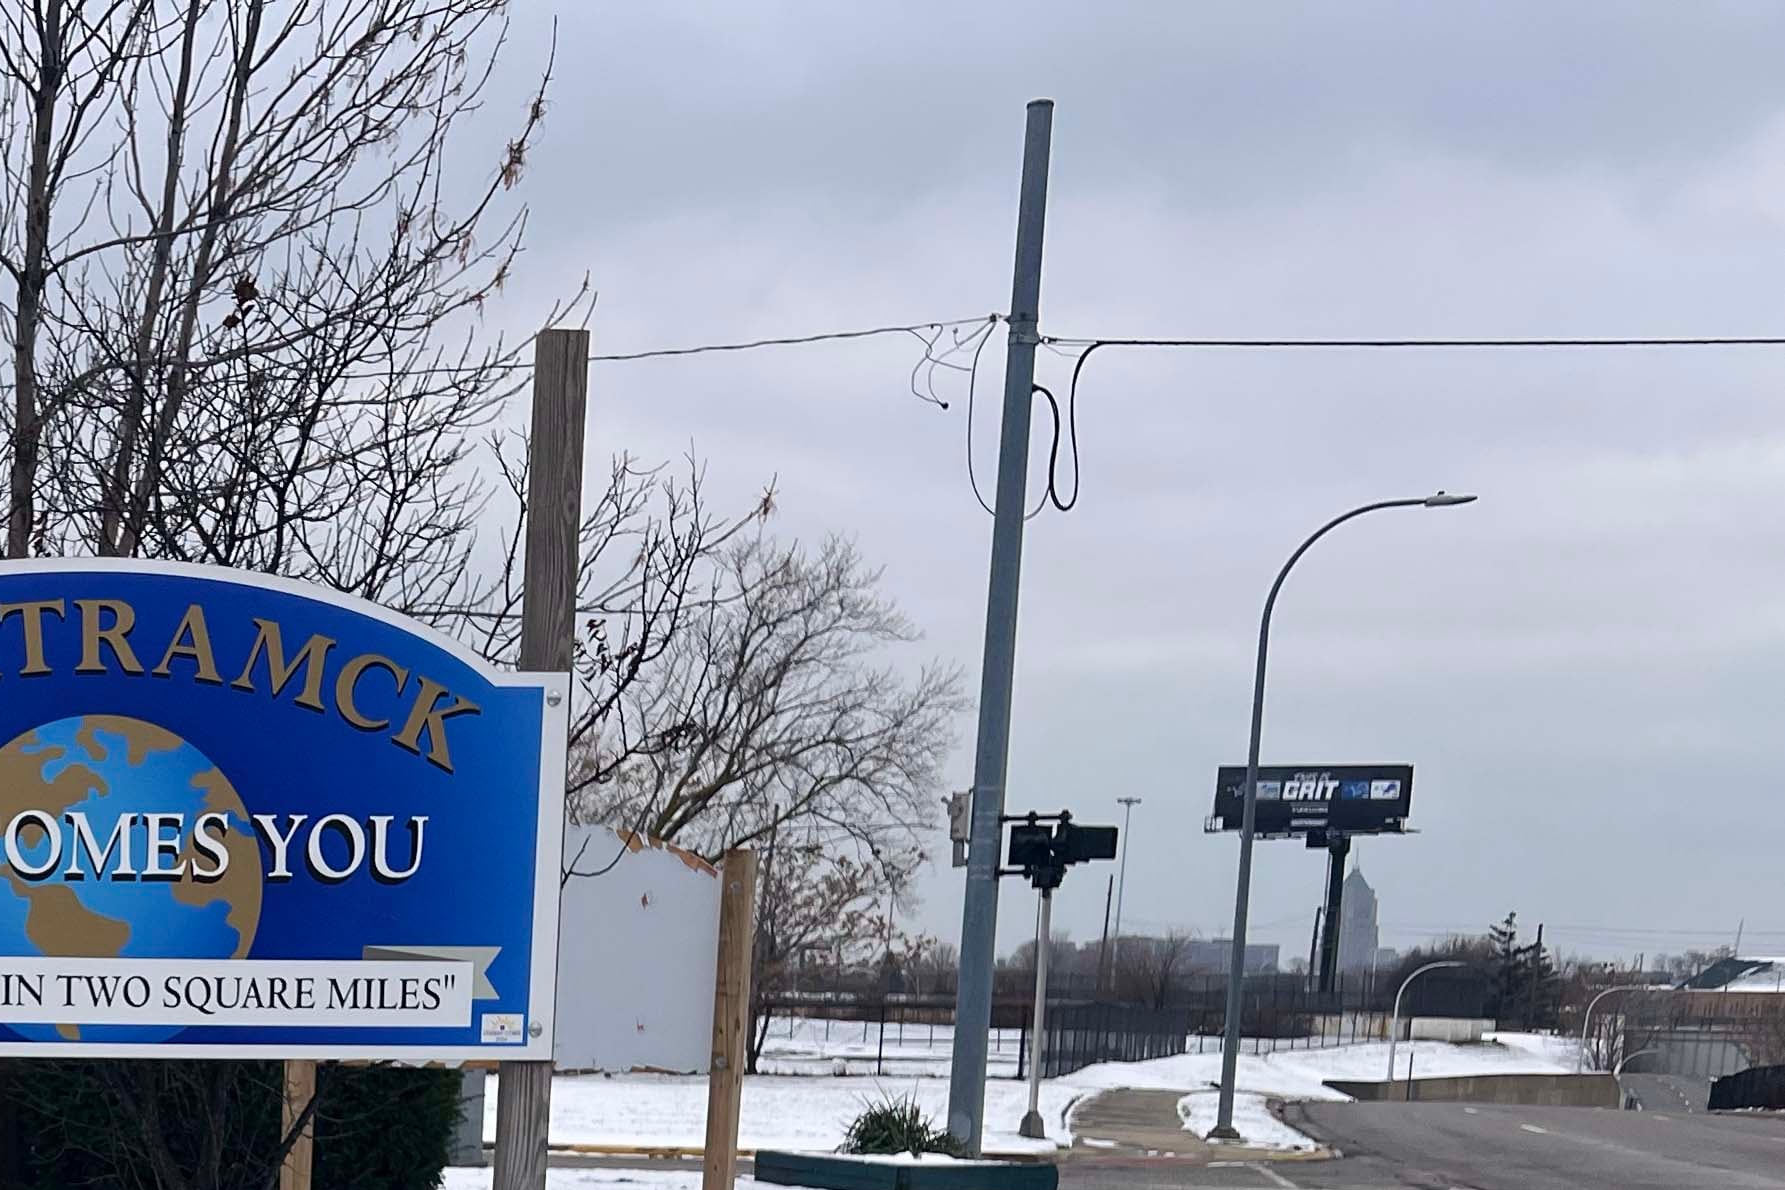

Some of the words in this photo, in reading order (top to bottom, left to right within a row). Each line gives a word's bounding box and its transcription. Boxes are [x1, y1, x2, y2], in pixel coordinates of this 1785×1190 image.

[1282, 780, 1340, 801] GRIT
[252, 813, 429, 882] YOU
[1, 973, 45, 1007] IN
[56, 974, 151, 1009] TWO
[162, 975, 316, 1015] SQUARE
[326, 973, 456, 1011] MILES"
